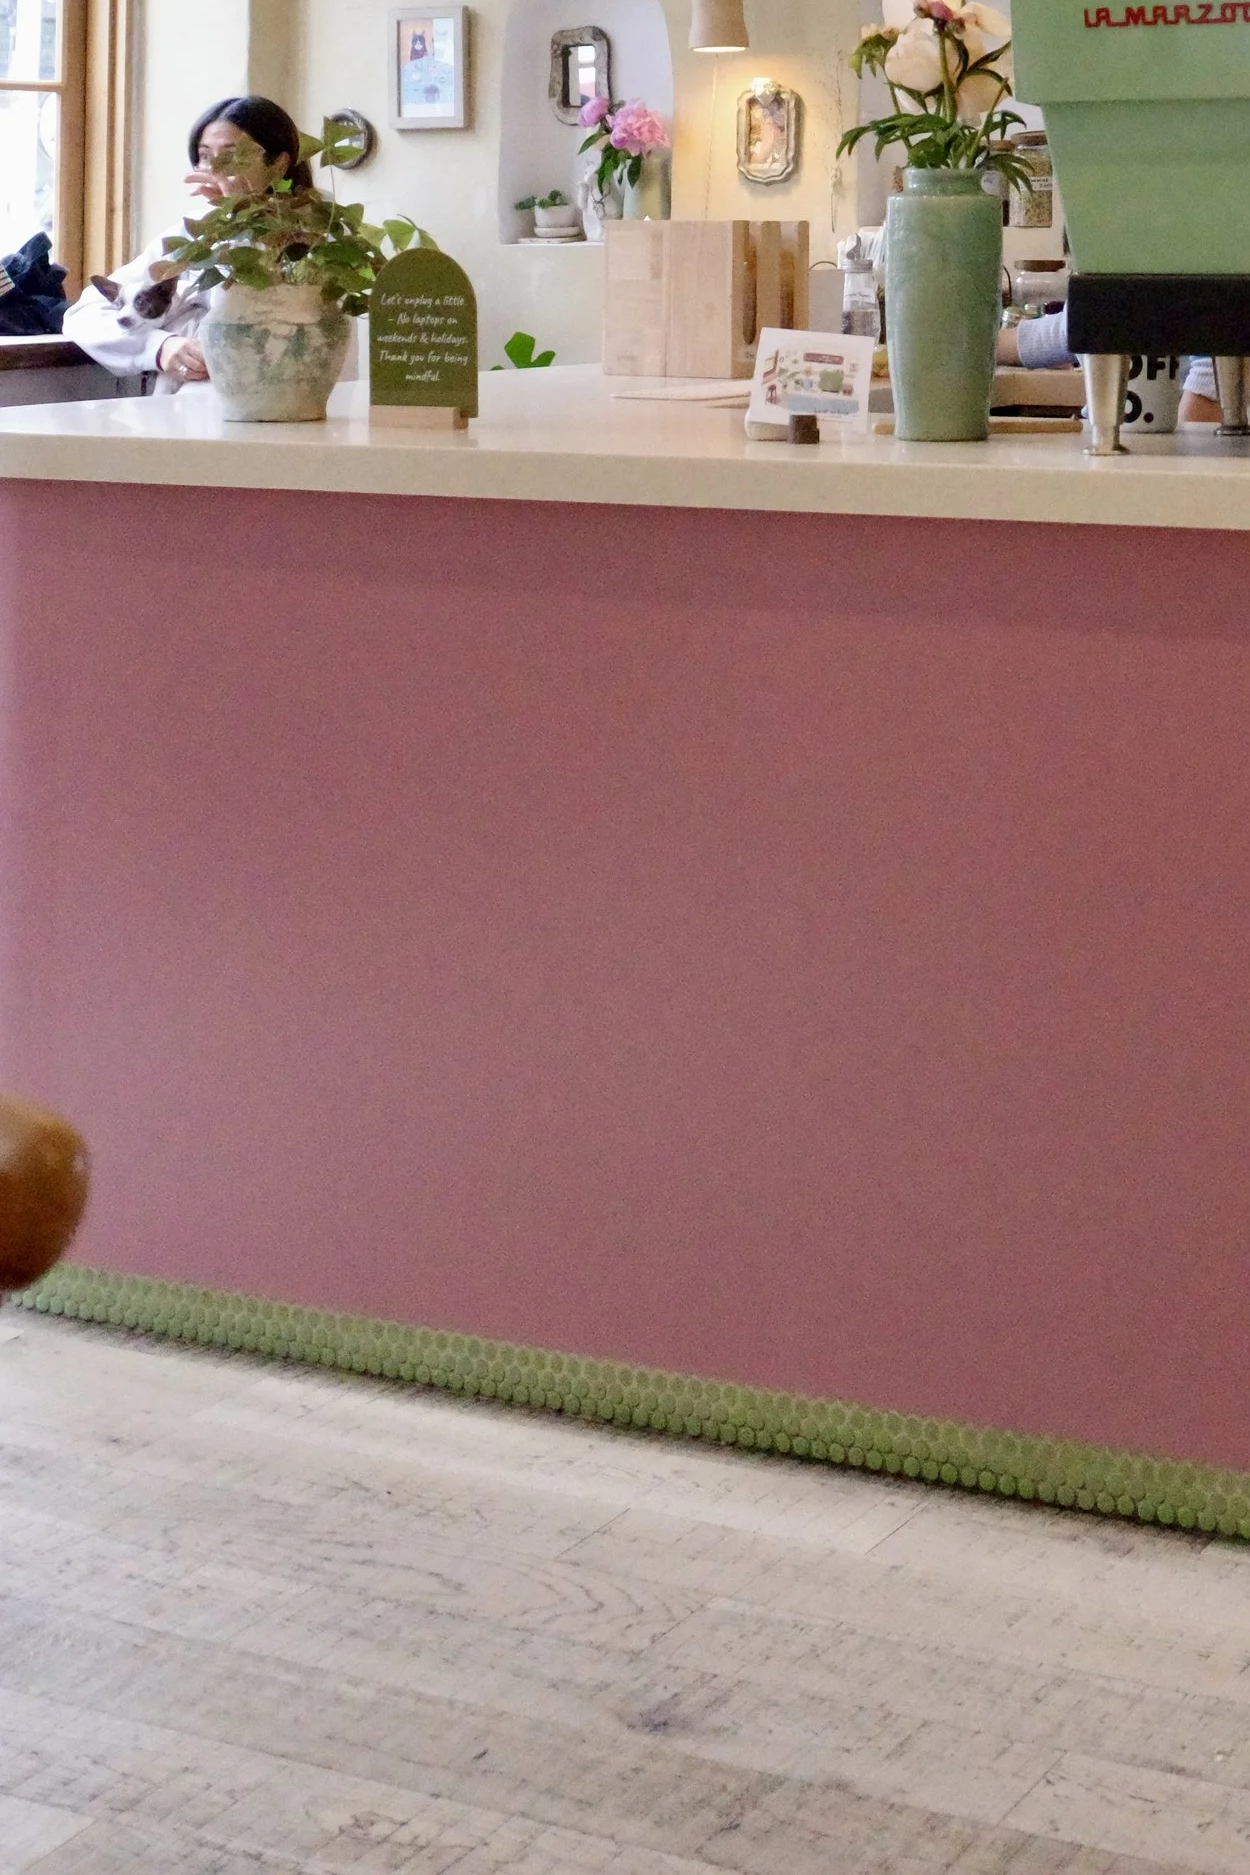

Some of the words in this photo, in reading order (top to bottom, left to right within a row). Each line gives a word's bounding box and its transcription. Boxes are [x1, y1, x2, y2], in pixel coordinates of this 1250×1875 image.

[380, 292, 402, 306] Let's
[404, 294, 433, 308] unplug
[435, 297, 441, 305] a
[442, 295, 465, 305] little
[396, 312, 411, 325] No
[412, 313, 445, 327] laptops
[376, 331, 417, 344] weekends
[420, 332, 429, 344] &
[379, 350, 408, 362] Thank
[409, 354, 425, 365] you
[427, 350, 441, 364] for
[444, 351, 469, 366] being
